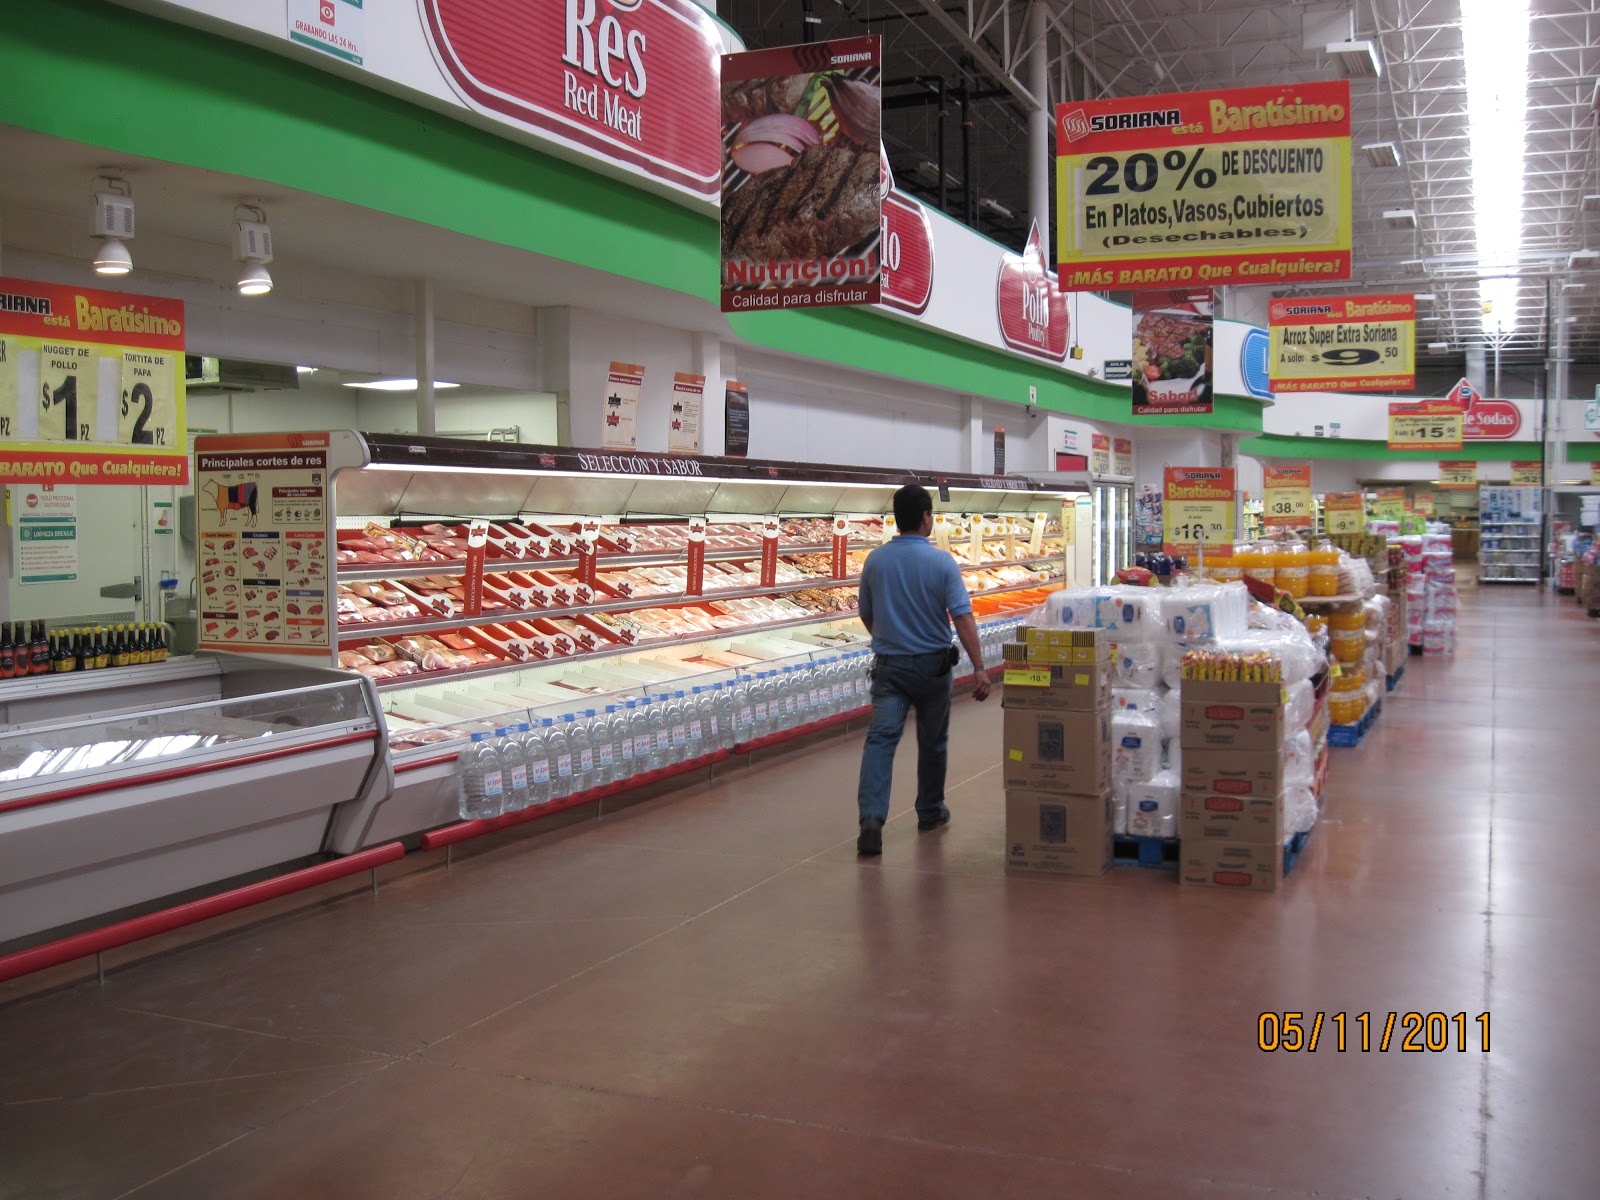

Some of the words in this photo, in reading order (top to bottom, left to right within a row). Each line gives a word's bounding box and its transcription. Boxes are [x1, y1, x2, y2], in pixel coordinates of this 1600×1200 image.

[295, 20, 327, 40] GRABANDO
[328, 32, 338, 44] LAS
[340, 37, 347, 47] 24
[347, 41, 359, 53] Hrs.
[562, 0, 647, 98] Res
[830, 52, 872, 65] SORIANA
[563, 70, 598, 121] Red
[603, 89, 642, 141] Meat
[1089, 108, 1181, 133] SORIANA
[1170, 122, 1204, 136] está
[1209, 97, 1345, 134] Baratísimo
[1085, 148, 1218, 196] 20%
[1222, 150, 1239, 176] DE
[1243, 148, 1323, 175] DESCUENTO
[1085, 205, 1107, 229] En
[1103, 225, 1308, 249] (Desechables)
[727, 252, 876, 284] Nutrición!
[1067, 267, 1114, 288] ¡MÁS
[1119, 265, 1193, 284] BARATO
[1199, 264, 1232, 280] Que
[1238, 258, 1341, 277] Cualquiera!
[732, 292, 779, 307] Calidad
[783, 292, 811, 307] para
[815, 288, 867, 303] disfrutar
[1022, 281, 1050, 328] Pollo
[44, 315, 71, 328] está
[75, 295, 181, 337] Baratísimo
[1286, 305, 1331, 315] SORIANA
[1345, 300, 1412, 318] Baratísimo
[1283, 327, 1307, 345] Arroz
[1309, 326, 1334, 347] Super
[1336, 325, 1360, 343] Extra
[1363, 324, 1397, 342] Soriana
[43, 344, 75, 356] NUGGET
[77, 348, 90, 357] DE
[125, 353, 153, 364] TORTITA
[154, 356, 165, 365] DE
[1280, 353, 1286, 363] A
[1287, 353, 1304, 363] solo:
[51, 360, 78, 370] POLLO
[133, 368, 152, 377] PAPA
[1299, 381, 1338, 390] BARATO
[1340, 381, 1357, 389] Que
[1359, 379, 1411, 387] Cualquiera!
[1149, 389, 1199, 402] Sabor!
[1137, 406, 1163, 414] Calidad
[1163, 407, 1179, 415] para
[1477, 411, 1513, 425] Sodas
[80, 423, 90, 441] PZ
[156, 427, 166, 445] PZ
[0, 461, 66, 476] BARATO
[70, 462, 98, 477] Que
[103, 460, 181, 477] Cualquiera!
[202, 457, 254, 469] Principales
[256, 458, 288, 467] cortes
[291, 456, 303, 465] de
[305, 457, 322, 465] res
[577, 453, 650, 474] SELECCIÓN
[650, 458, 661, 474] Y
[663, 458, 703, 476] SABOR
[1168, 482, 1231, 499] Baratísimo
